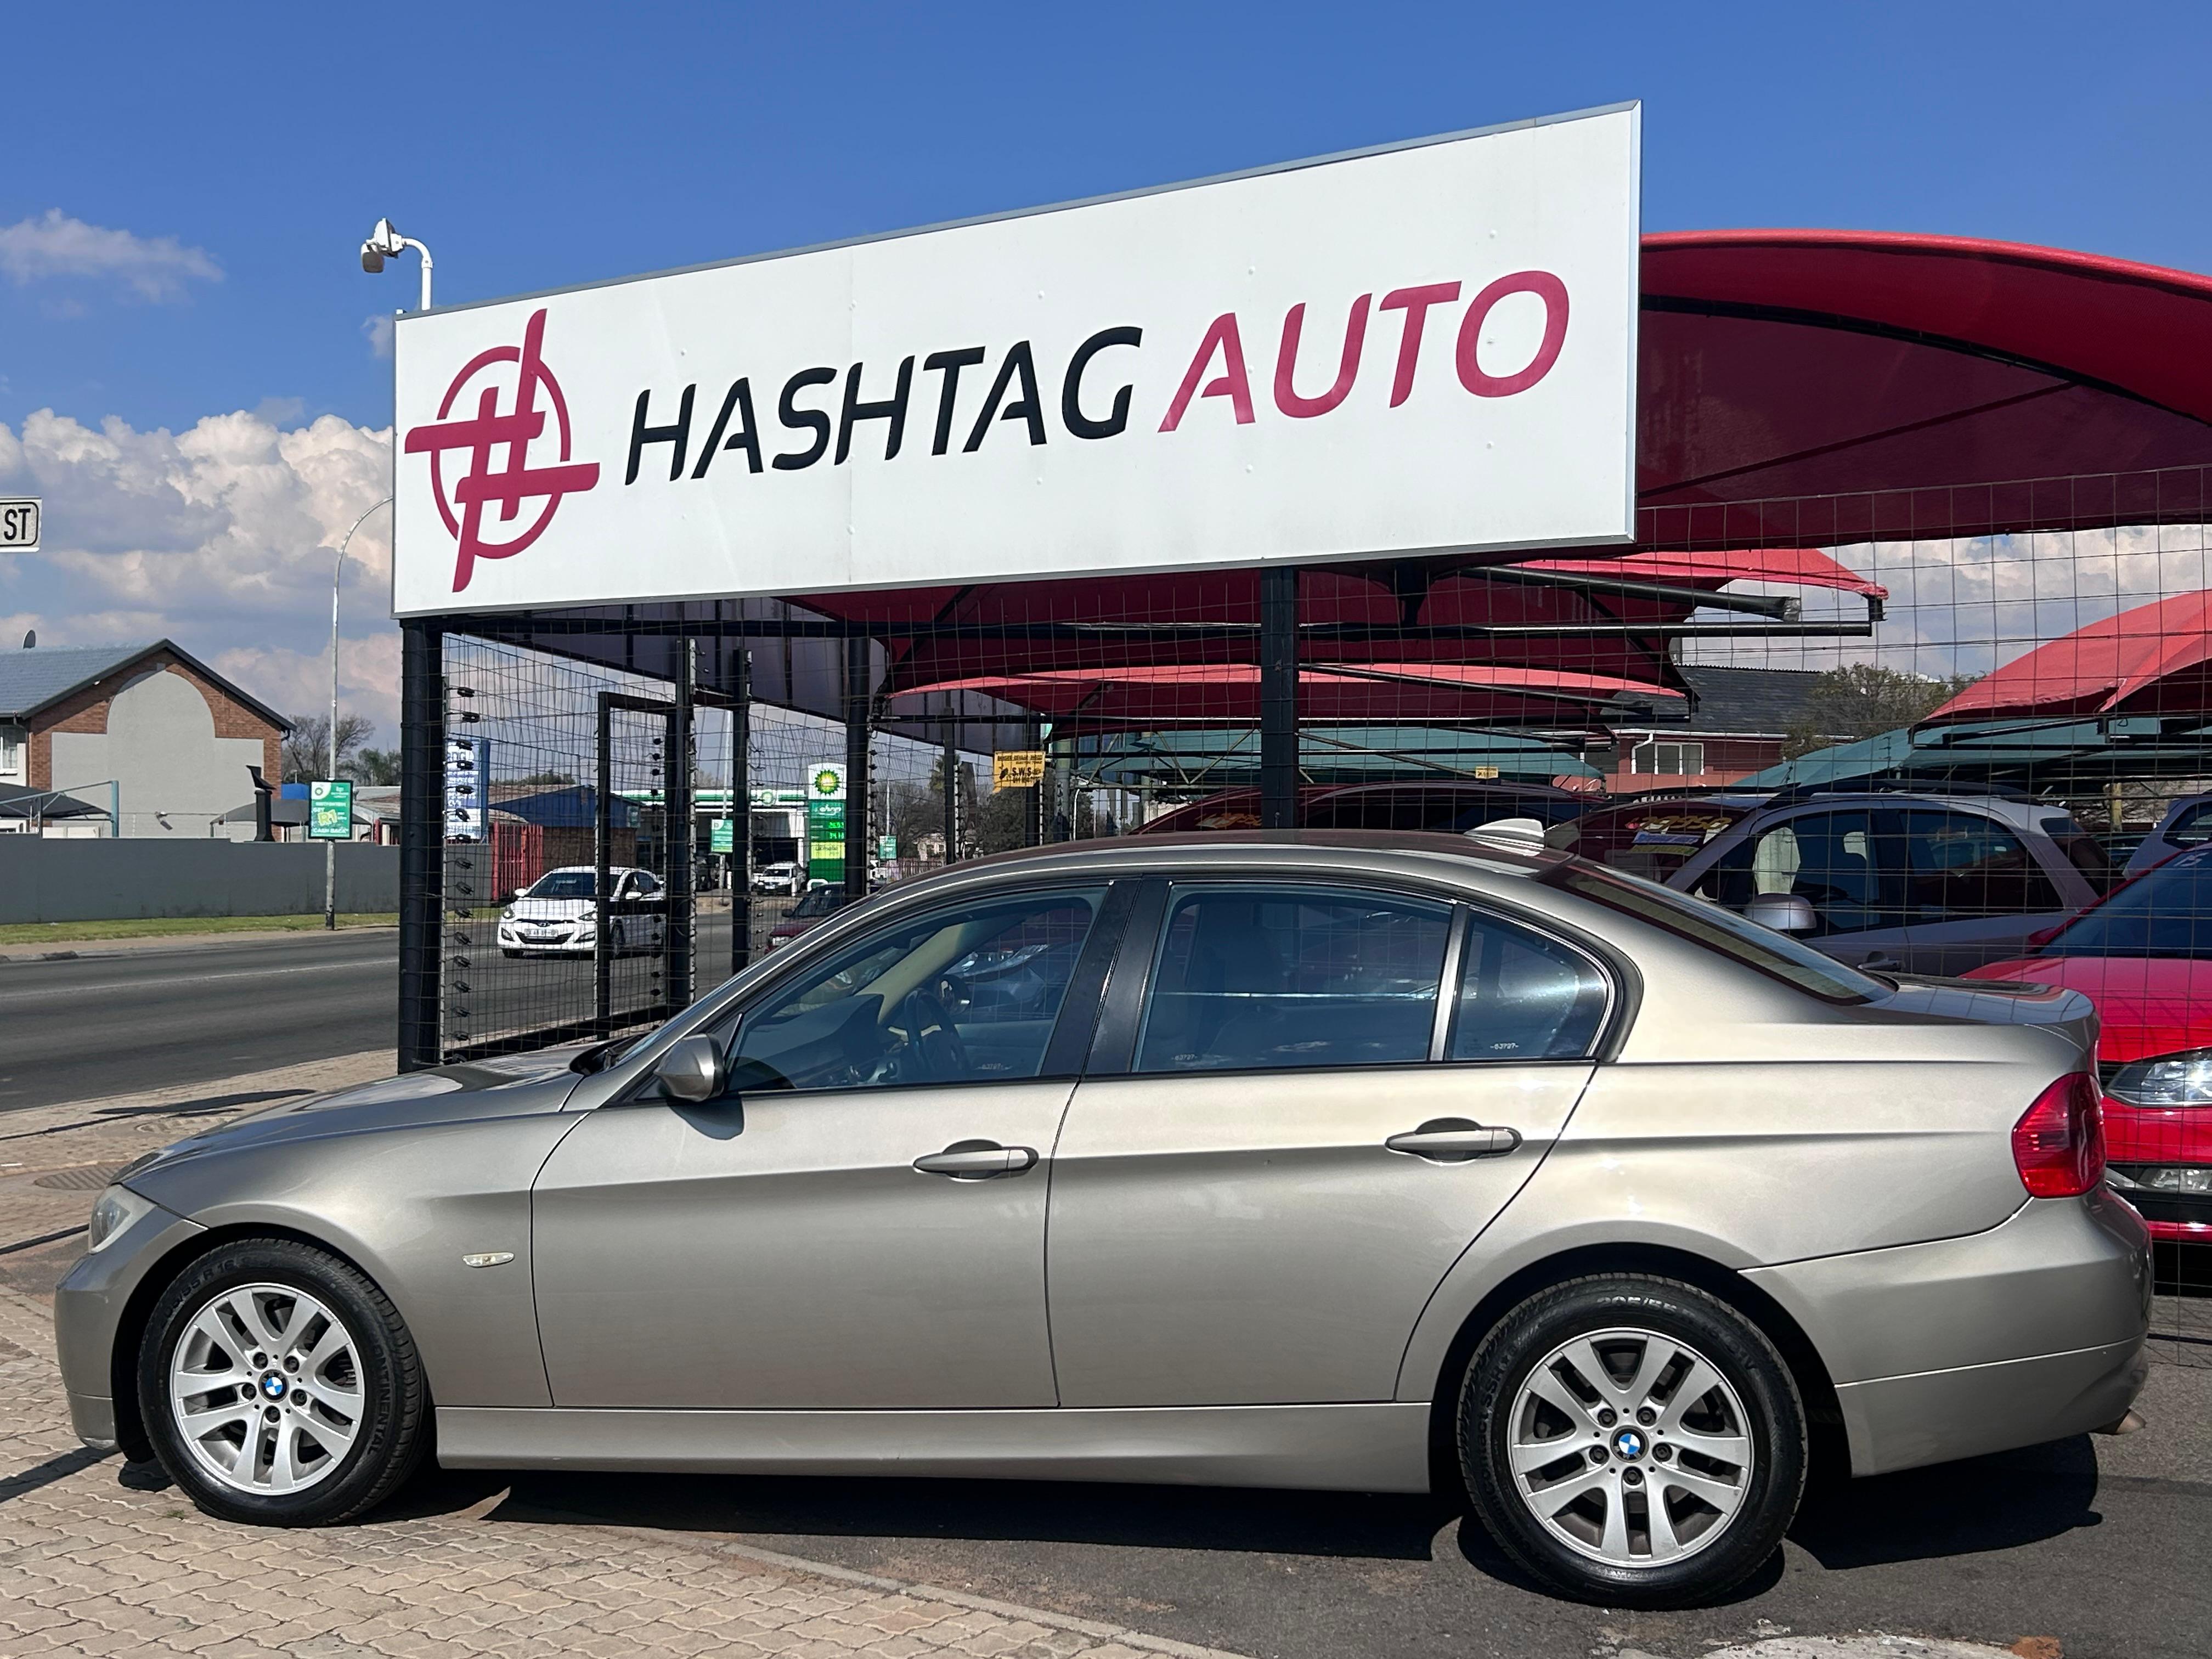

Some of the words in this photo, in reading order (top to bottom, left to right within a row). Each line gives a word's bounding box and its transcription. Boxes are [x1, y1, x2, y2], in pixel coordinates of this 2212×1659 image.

[625, 326, 1143, 486] HASHTAG
[1160, 270, 1568, 431] AUTO
[4, 508, 31, 540] ST
